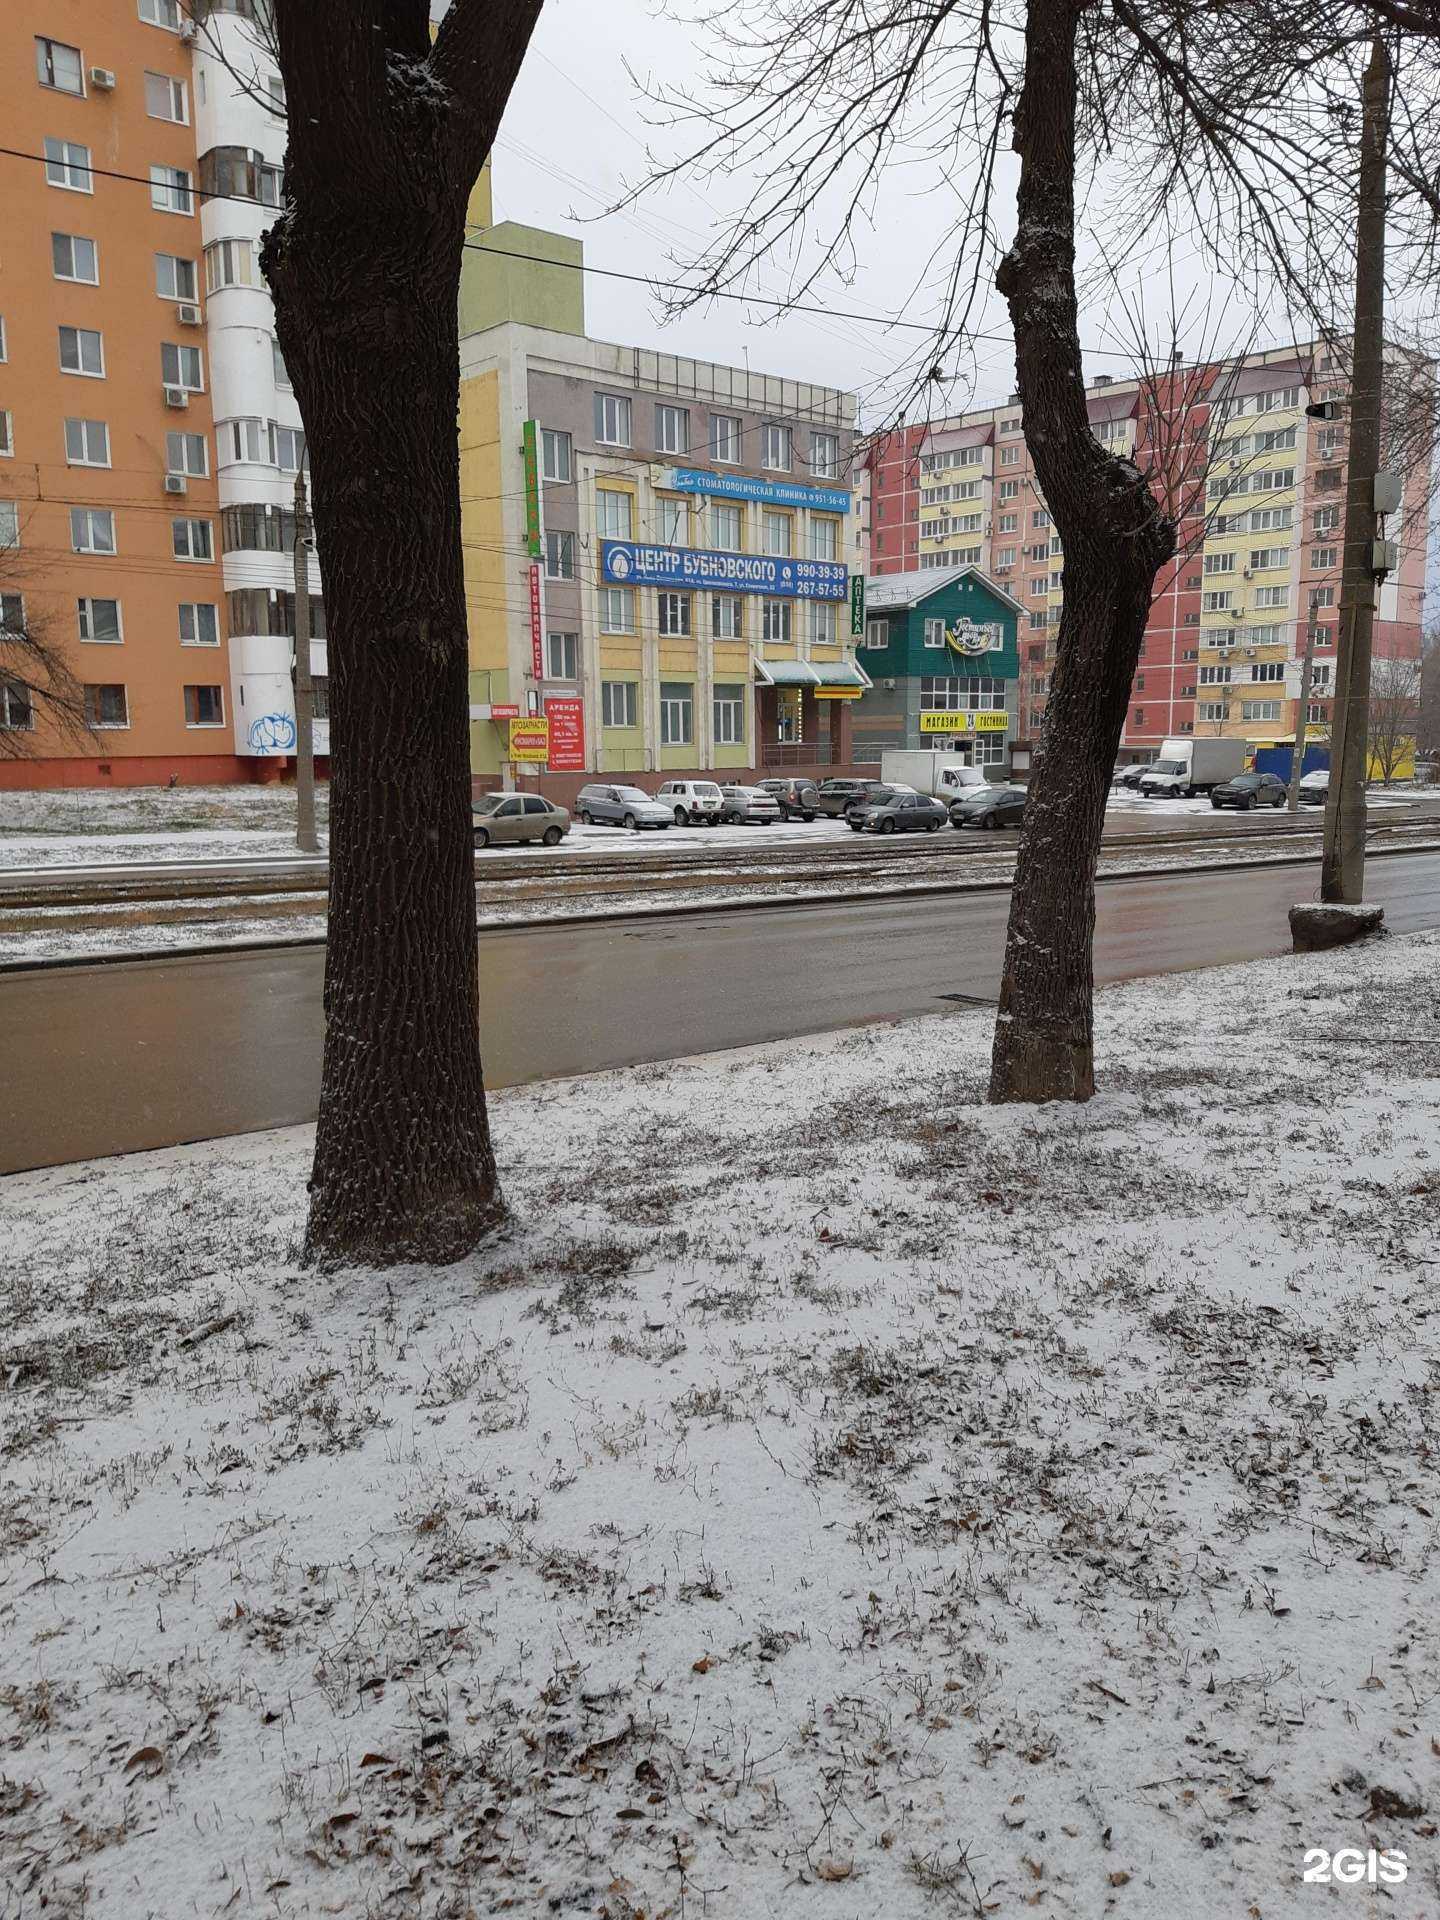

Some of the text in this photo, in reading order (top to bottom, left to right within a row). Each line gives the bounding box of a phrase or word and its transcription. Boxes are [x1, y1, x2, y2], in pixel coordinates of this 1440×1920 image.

[697, 476, 774, 497] СТОМАТОЛОГИЧЕСКАЯ
[776, 488, 807, 501] КЛИНИКА
[634, 548, 776, 582] ЦЕНТР БУБНОВСКОГО
[796, 563, 845, 580] 990-39-39
[796, 580, 845, 597] 267-57-55
[854, 576, 863, 633] АПТЕКА
[926, 716, 959, 728] МАГАЗИН
